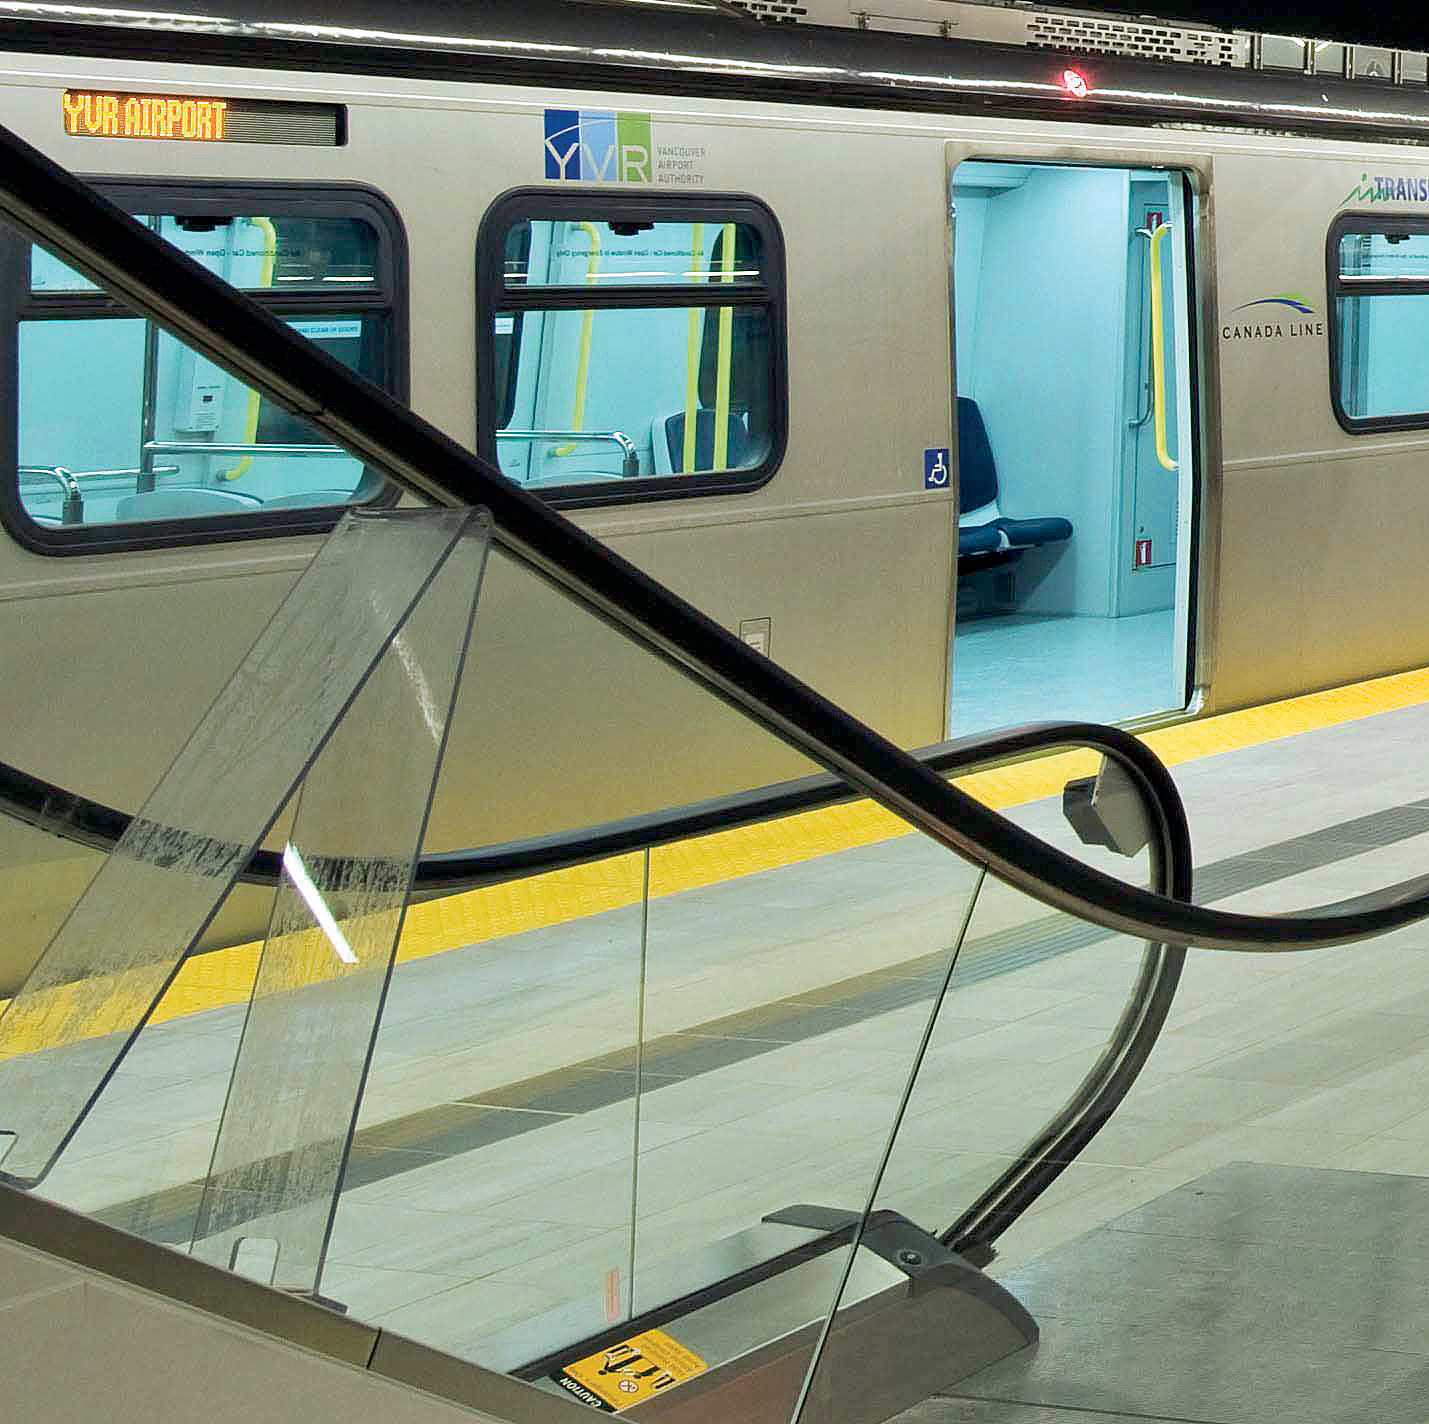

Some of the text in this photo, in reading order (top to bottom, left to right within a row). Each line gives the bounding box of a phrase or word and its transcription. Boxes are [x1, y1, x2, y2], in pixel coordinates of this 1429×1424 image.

[64, 93, 227, 139] YVR AIRPORT
[656, 146, 706, 157] VANCOUVER
[545, 140, 651, 184] YVR
[657, 160, 695, 170] AIRPORT
[657, 174, 706, 184] AUTHORITY
[1222, 322, 1323, 340] CANADA LINE
[559, 1376, 603, 1408] CAUTION
